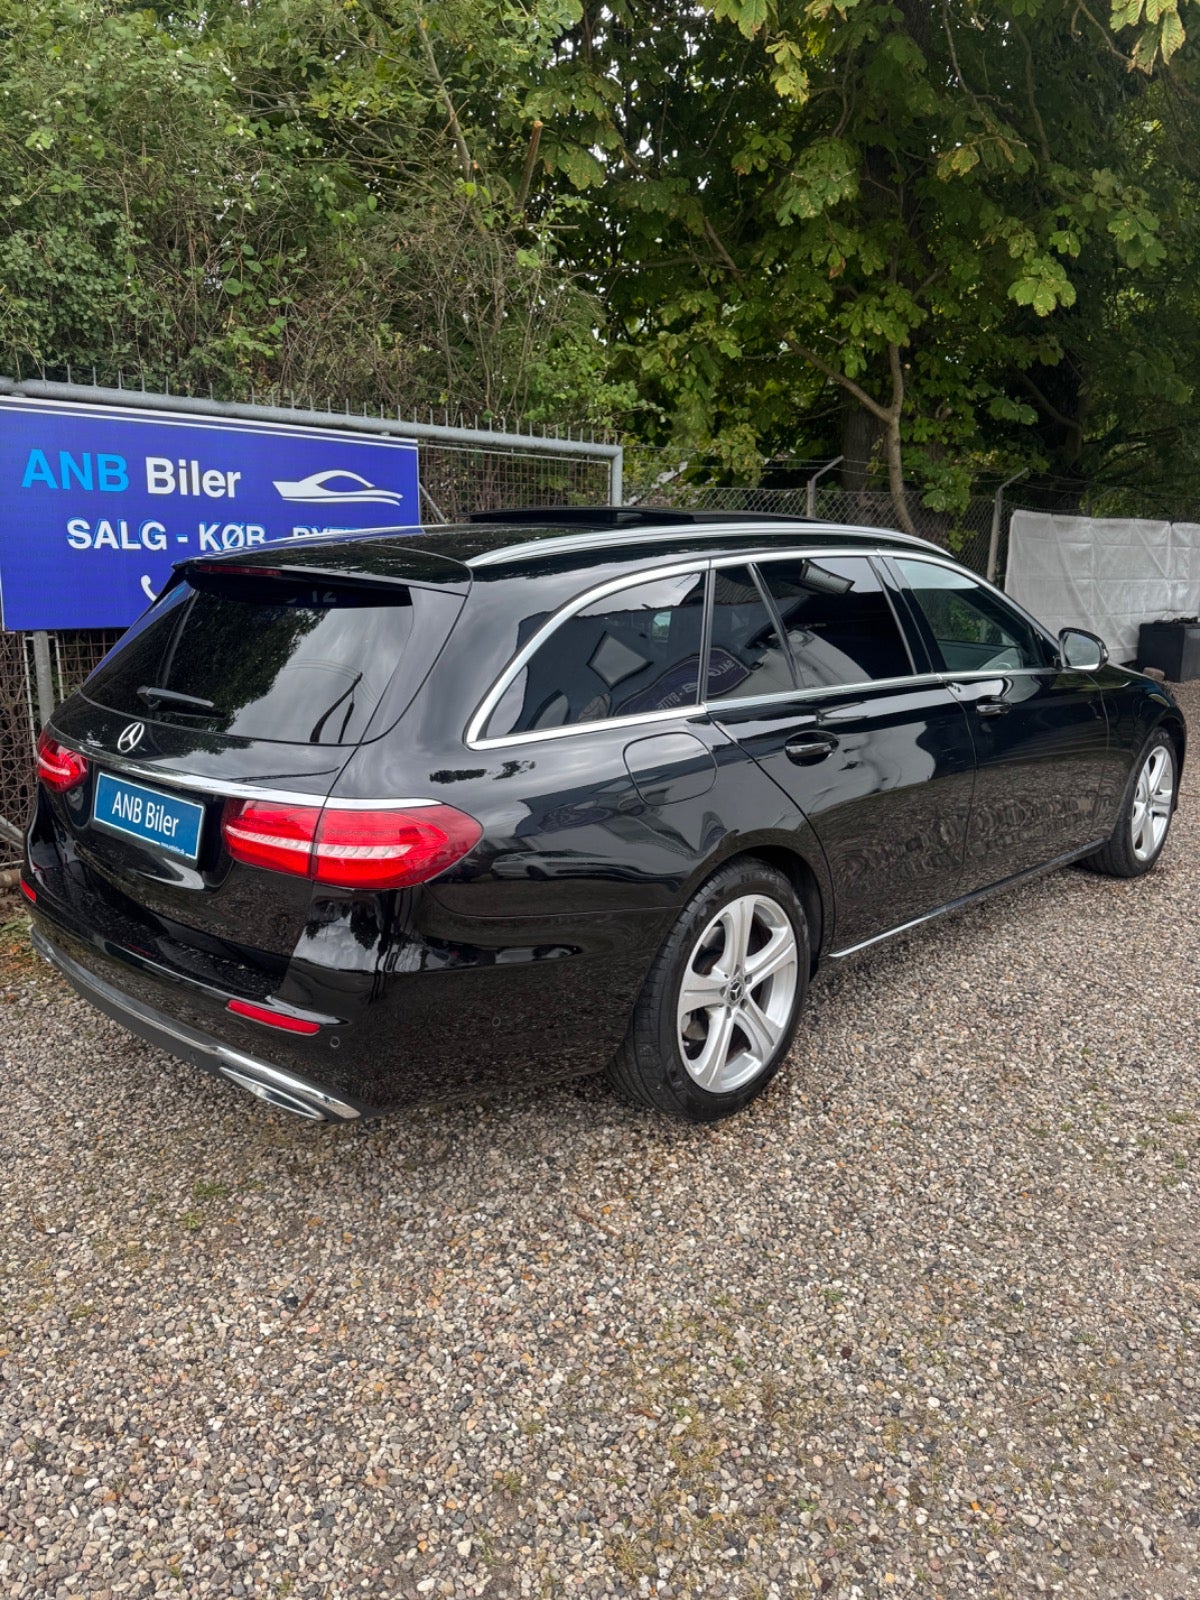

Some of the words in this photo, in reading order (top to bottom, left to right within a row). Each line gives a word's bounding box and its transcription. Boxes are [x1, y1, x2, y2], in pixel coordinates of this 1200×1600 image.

[21, 448, 129, 492] ANB
[145, 456, 241, 498] Biler
[66, 519, 168, 551] SALG
[199, 522, 266, 551] KØB
[111, 791, 142, 824] ANB
[145, 801, 179, 837] Biler
